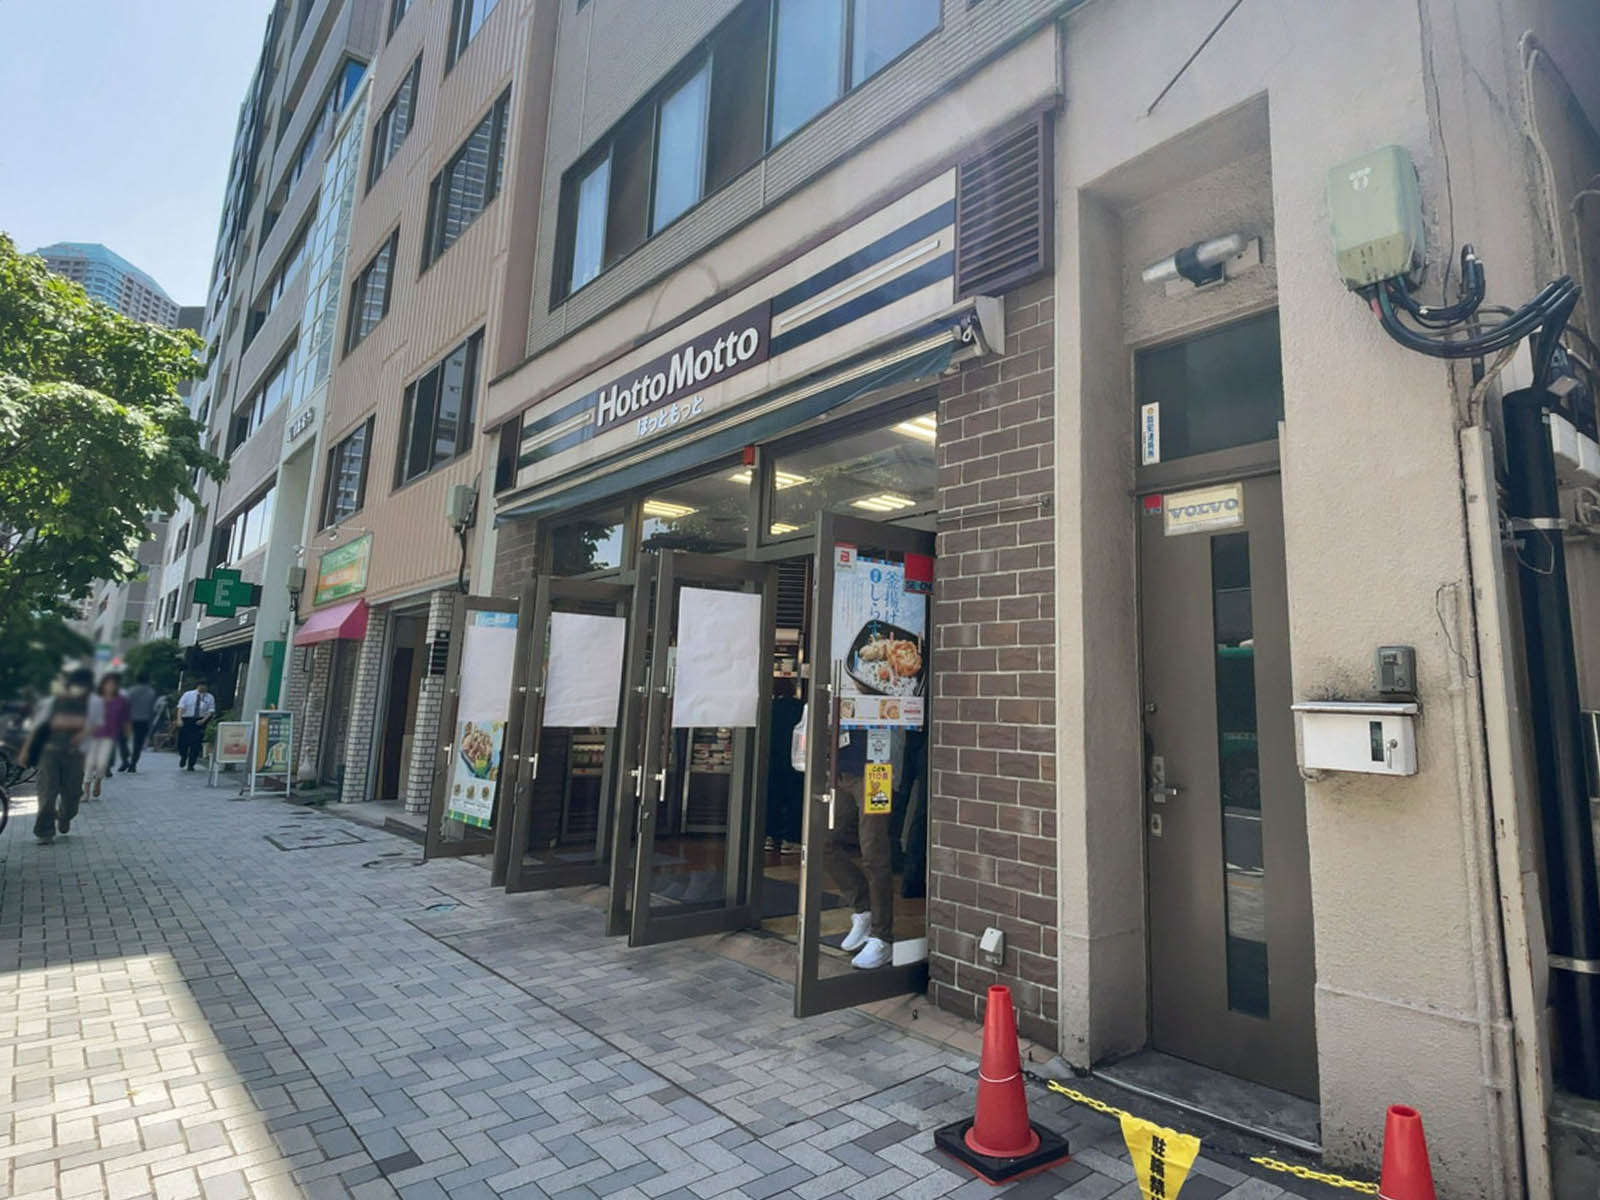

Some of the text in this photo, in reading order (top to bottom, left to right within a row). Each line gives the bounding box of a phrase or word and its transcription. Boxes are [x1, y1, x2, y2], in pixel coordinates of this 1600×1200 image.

[596, 326, 759, 427] HottoMotto
[636, 394, 704, 437] ほっともっと
[1168, 497, 1239, 519] VOLVO
